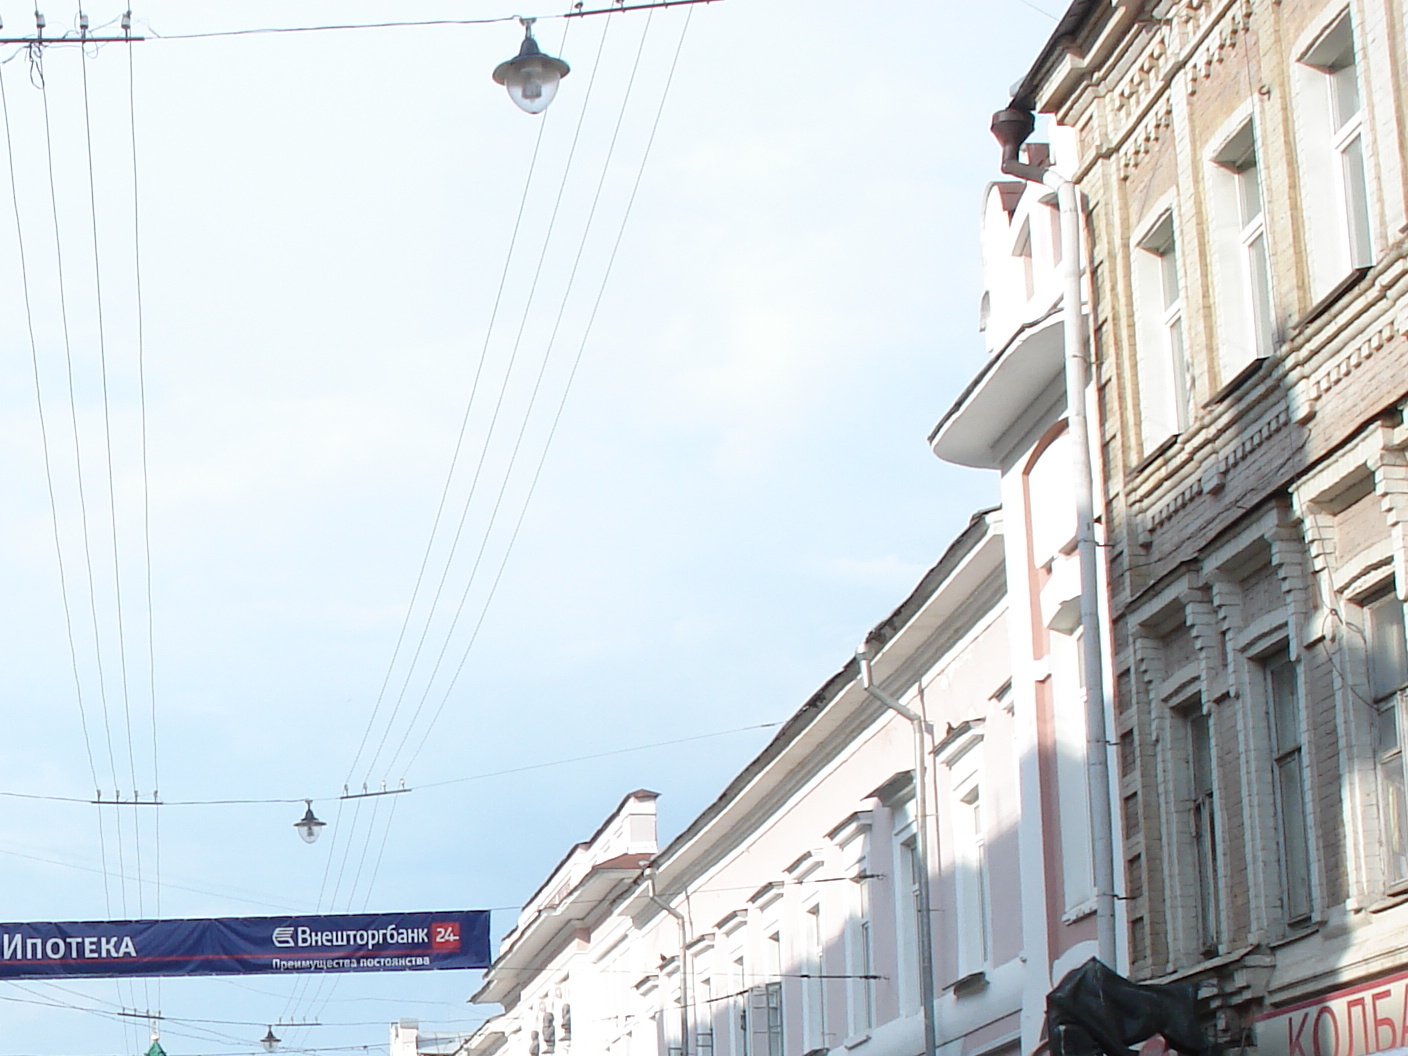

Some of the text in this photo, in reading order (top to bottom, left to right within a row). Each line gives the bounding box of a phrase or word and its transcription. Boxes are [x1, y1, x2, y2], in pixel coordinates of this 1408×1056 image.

[297, 925, 460, 950] Внешторгбанк 24
[273, 956, 430, 971] Преимущества постоянства
